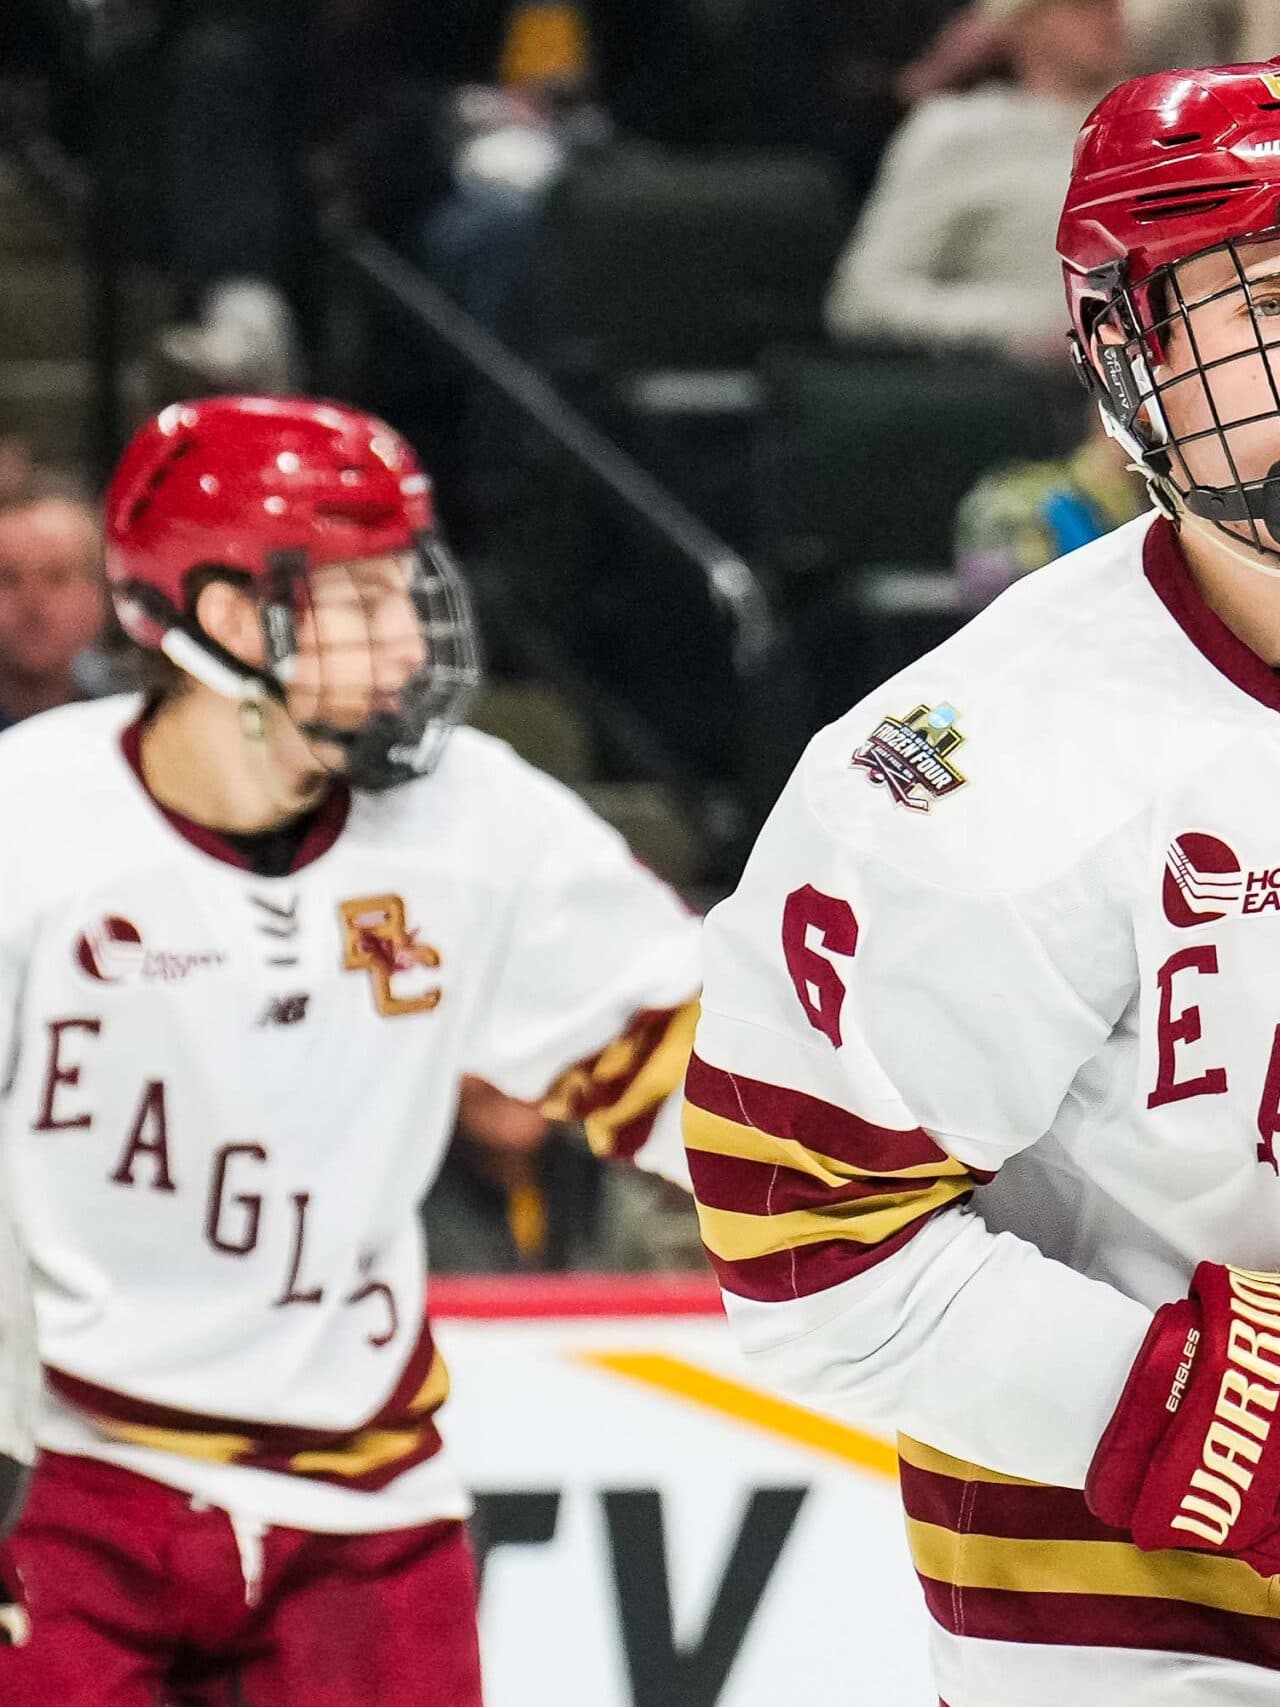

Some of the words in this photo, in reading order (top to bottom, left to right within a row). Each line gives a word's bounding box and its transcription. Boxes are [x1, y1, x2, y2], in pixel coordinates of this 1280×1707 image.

[872, 722, 921, 759] FROZEN
[909, 751, 953, 790] FOUR
[781, 882, 860, 1051] 6
[1165, 1327, 1201, 1414] EAGLES
